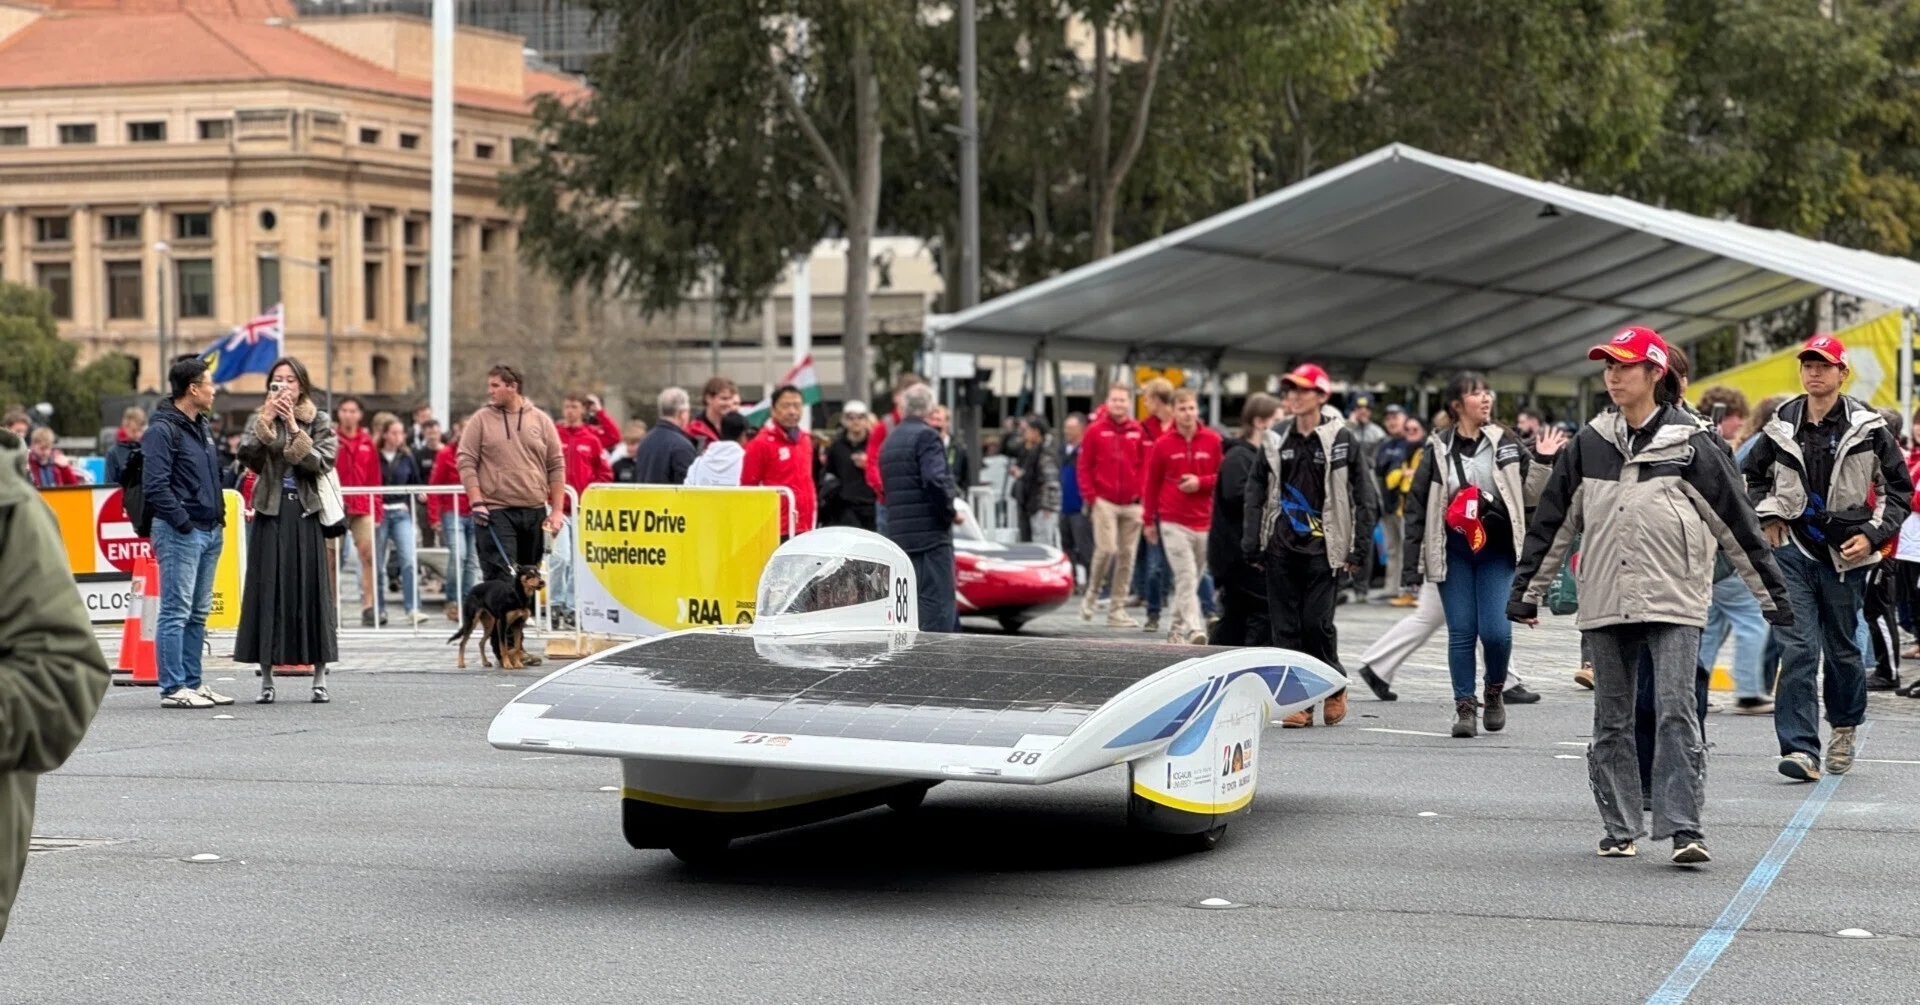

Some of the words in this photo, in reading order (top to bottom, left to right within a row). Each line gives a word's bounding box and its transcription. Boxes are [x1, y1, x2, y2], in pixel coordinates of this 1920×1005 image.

[585, 509, 614, 531] RAA
[619, 510, 640, 532] EV
[644, 508, 686, 533] Drive
[108, 542, 152, 560] ENTR
[585, 540, 666, 569] Experience
[86, 593, 131, 610] CLOS
[688, 598, 722, 625] RAA
[896, 577, 908, 623] 88
[1006, 750, 1042, 765] 88
